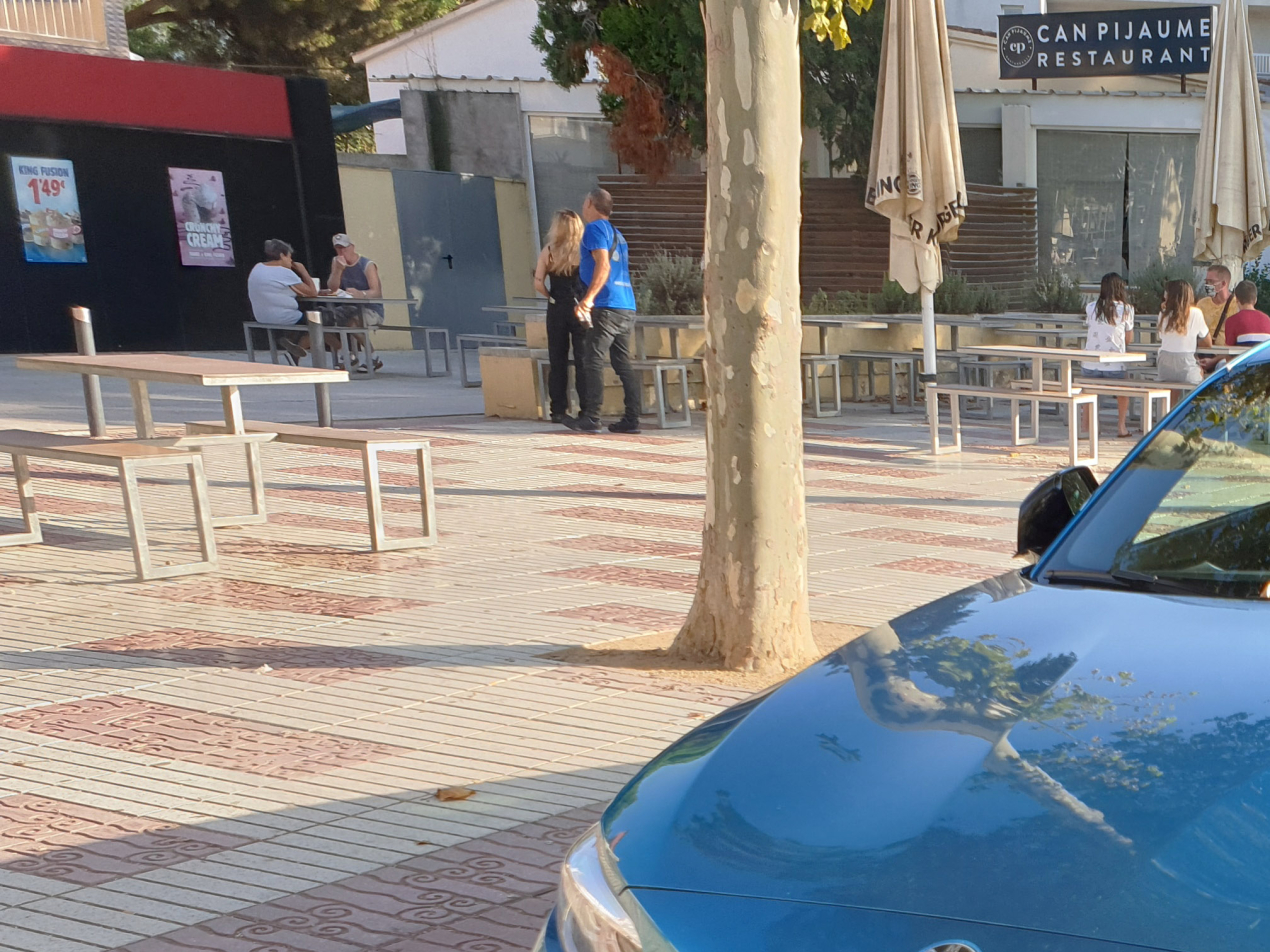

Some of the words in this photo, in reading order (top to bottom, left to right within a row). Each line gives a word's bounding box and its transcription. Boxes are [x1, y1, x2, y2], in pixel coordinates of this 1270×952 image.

[1037, 23, 1087, 43] CAN
[1098, 18, 1211, 41] PIJAUME
[1009, 42, 1027, 55] cp
[1037, 47, 1210, 68] RESTAURANT
[18, 165, 39, 176] KING
[41, 167, 70, 178] FUSION
[184, 221, 221, 234] CRUNCHY
[186, 232, 225, 249] CREAM
